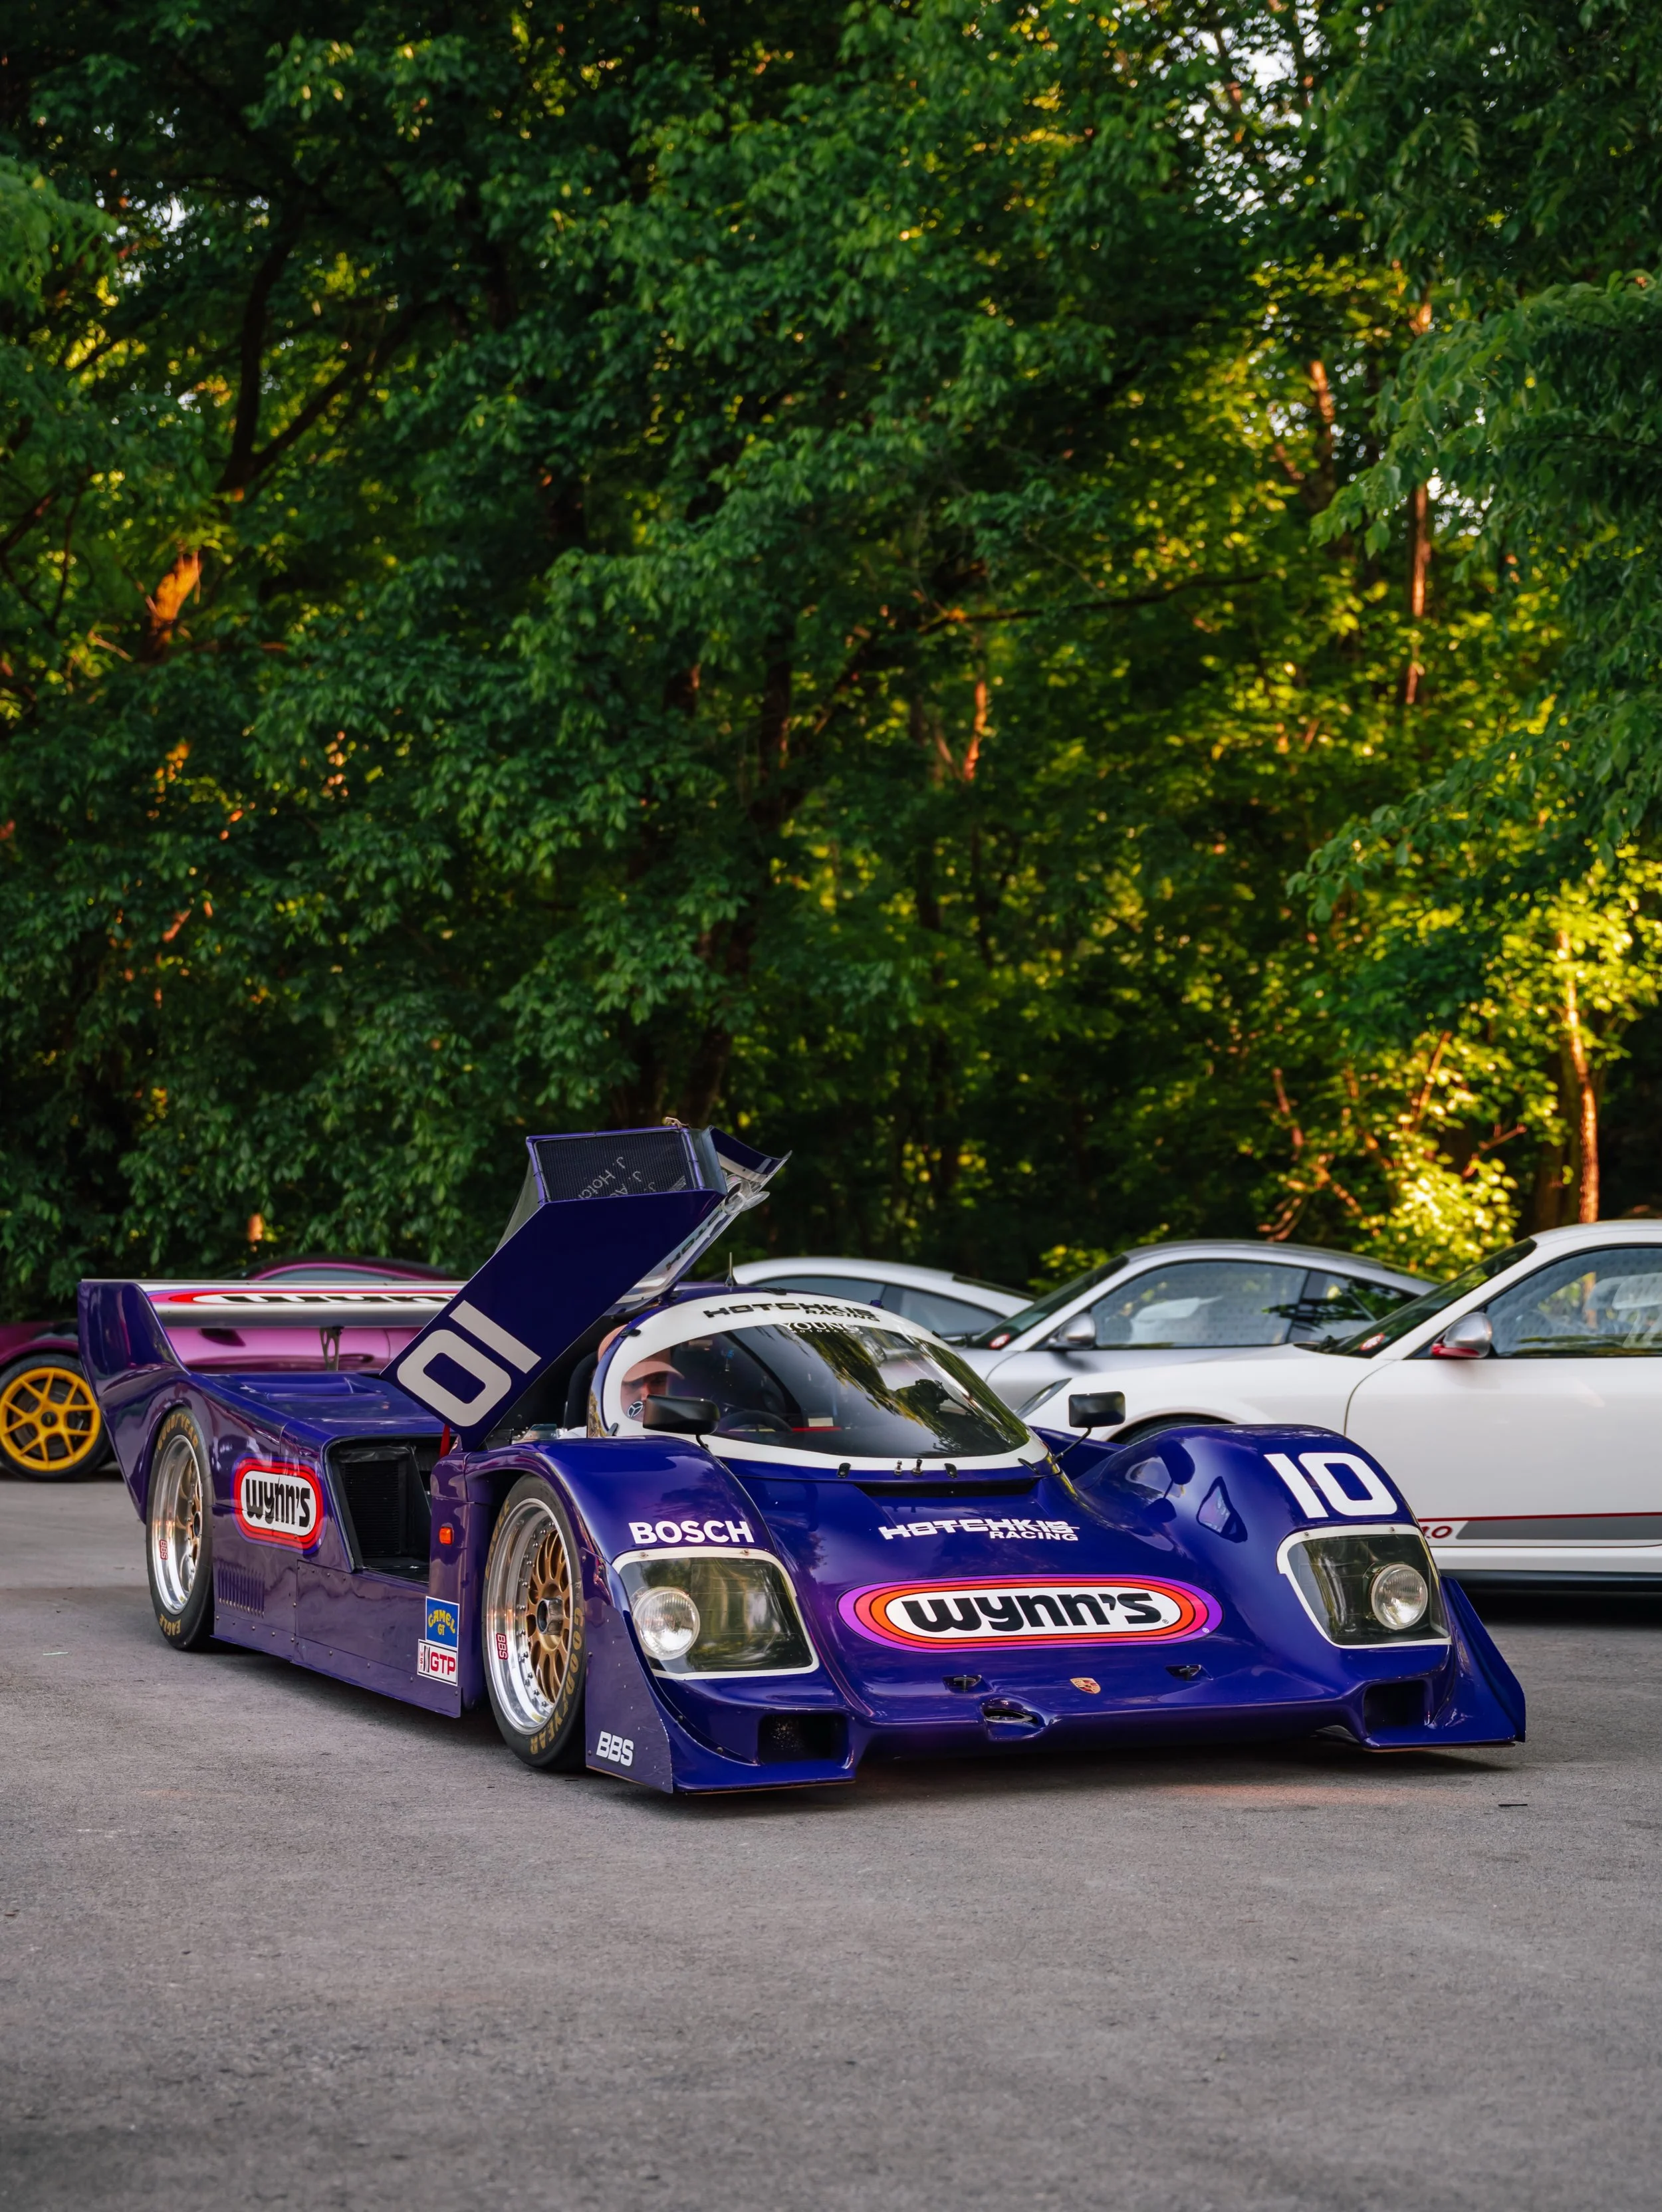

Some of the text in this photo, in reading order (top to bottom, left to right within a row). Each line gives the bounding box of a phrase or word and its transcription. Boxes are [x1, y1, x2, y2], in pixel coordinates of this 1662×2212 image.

[703, 1303, 877, 1319] HOTCHKIS
[805, 1309, 881, 1322] RACING
[778, 1322, 860, 1331] YOUNG
[1264, 1452, 1397, 1518] 10
[628, 1520, 755, 1544] BOSCH
[878, 1518, 1080, 1540] HOTCHKIS
[989, 1531, 1079, 1541] RACING
[159, 1613, 181, 1636] EAGLE
[427, 1609, 456, 1634] CAMEL
[437, 1624, 445, 1635] GT
[497, 1634, 508, 1660] BBS
[430, 1652, 456, 1676] GTP
[596, 1731, 634, 1767] BBS
